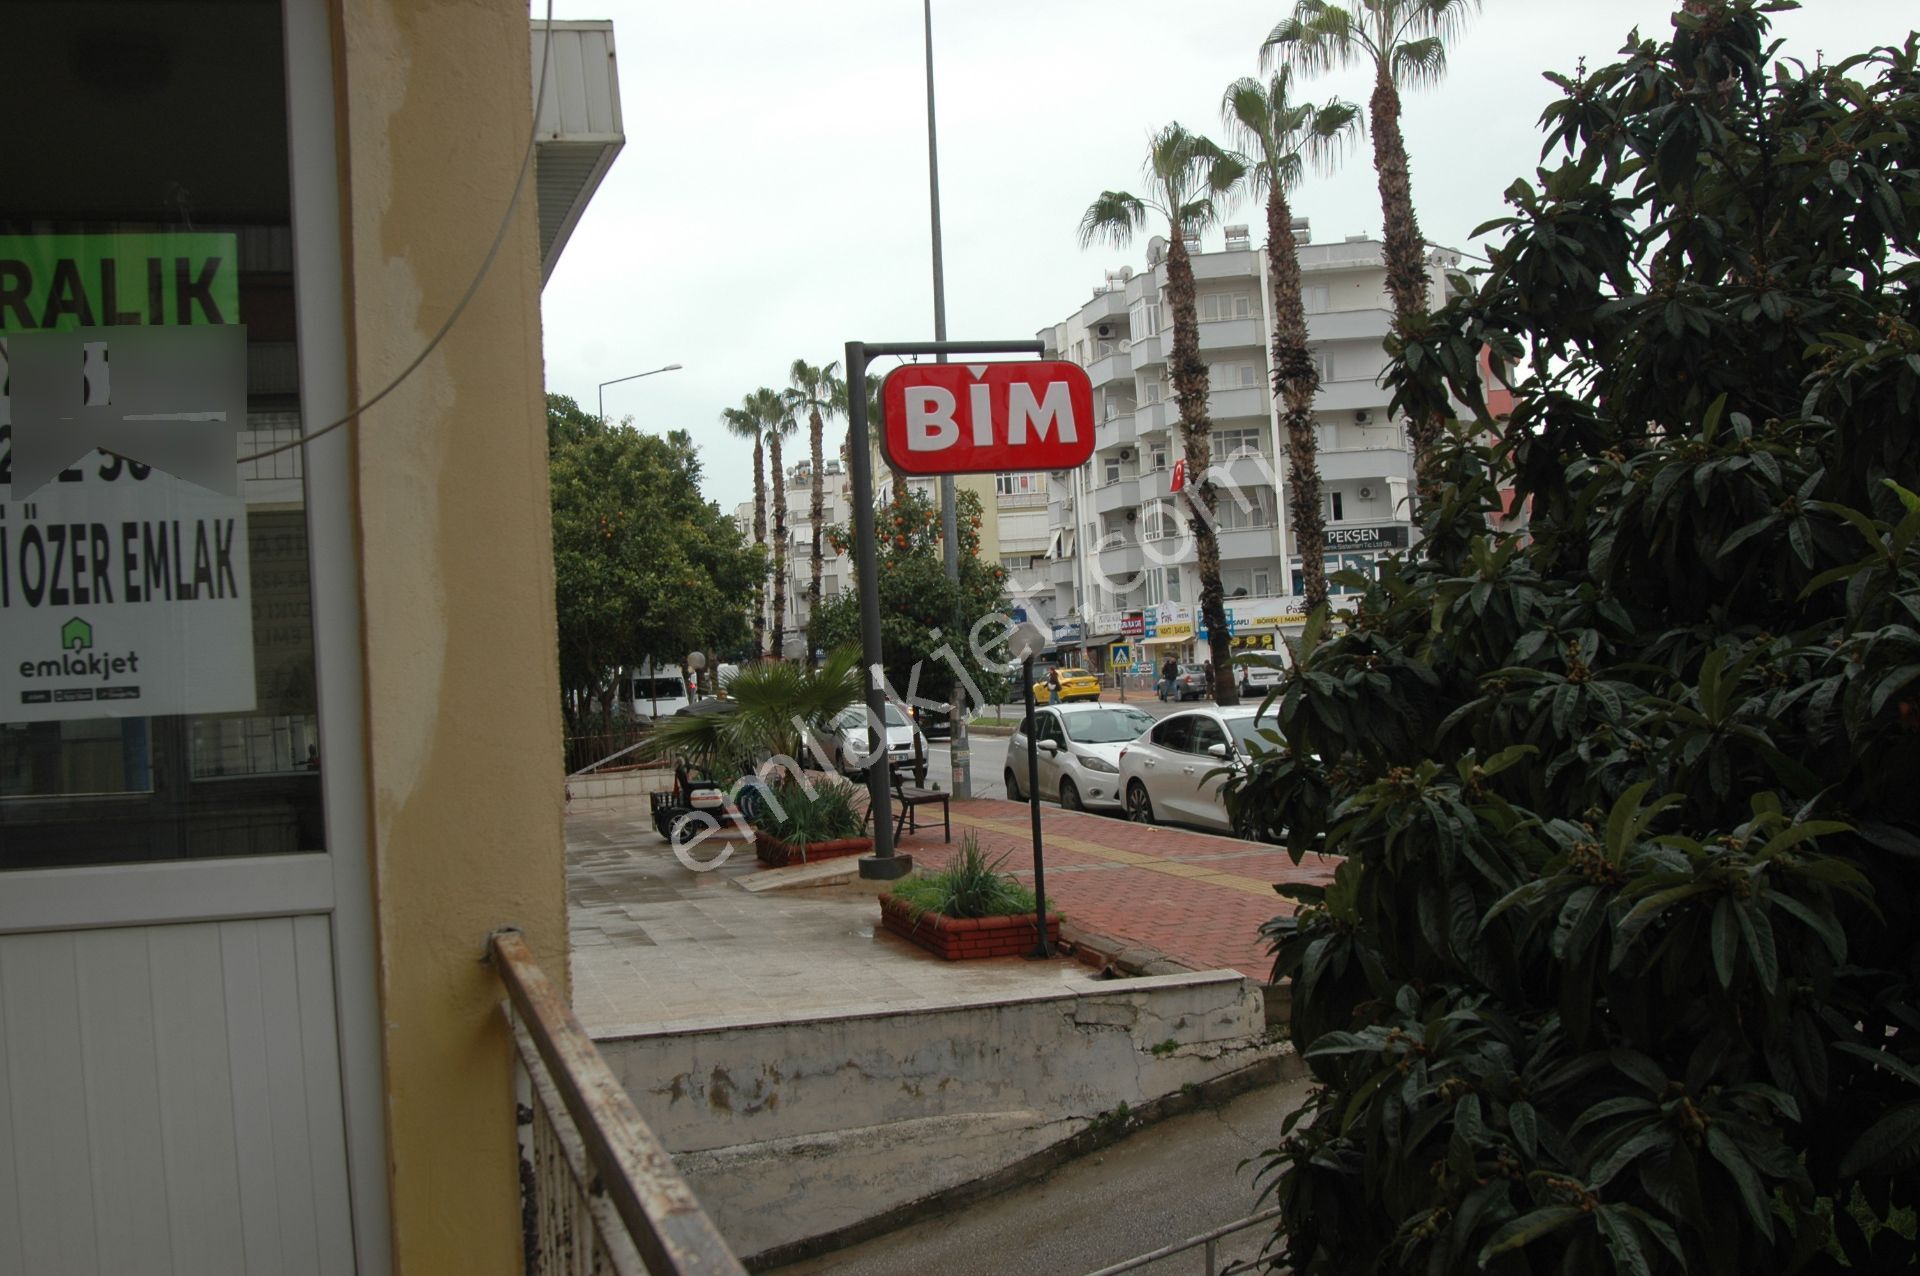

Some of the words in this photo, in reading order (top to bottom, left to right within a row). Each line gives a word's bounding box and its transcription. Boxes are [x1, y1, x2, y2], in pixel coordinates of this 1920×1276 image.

[904, 365, 1078, 452] BİM
[20, 503, 114, 608] ÖZER
[122, 518, 238, 602] EMLAK
[1328, 529, 1379, 543] PEKŞEN
[20, 651, 138, 680] emlakjet
